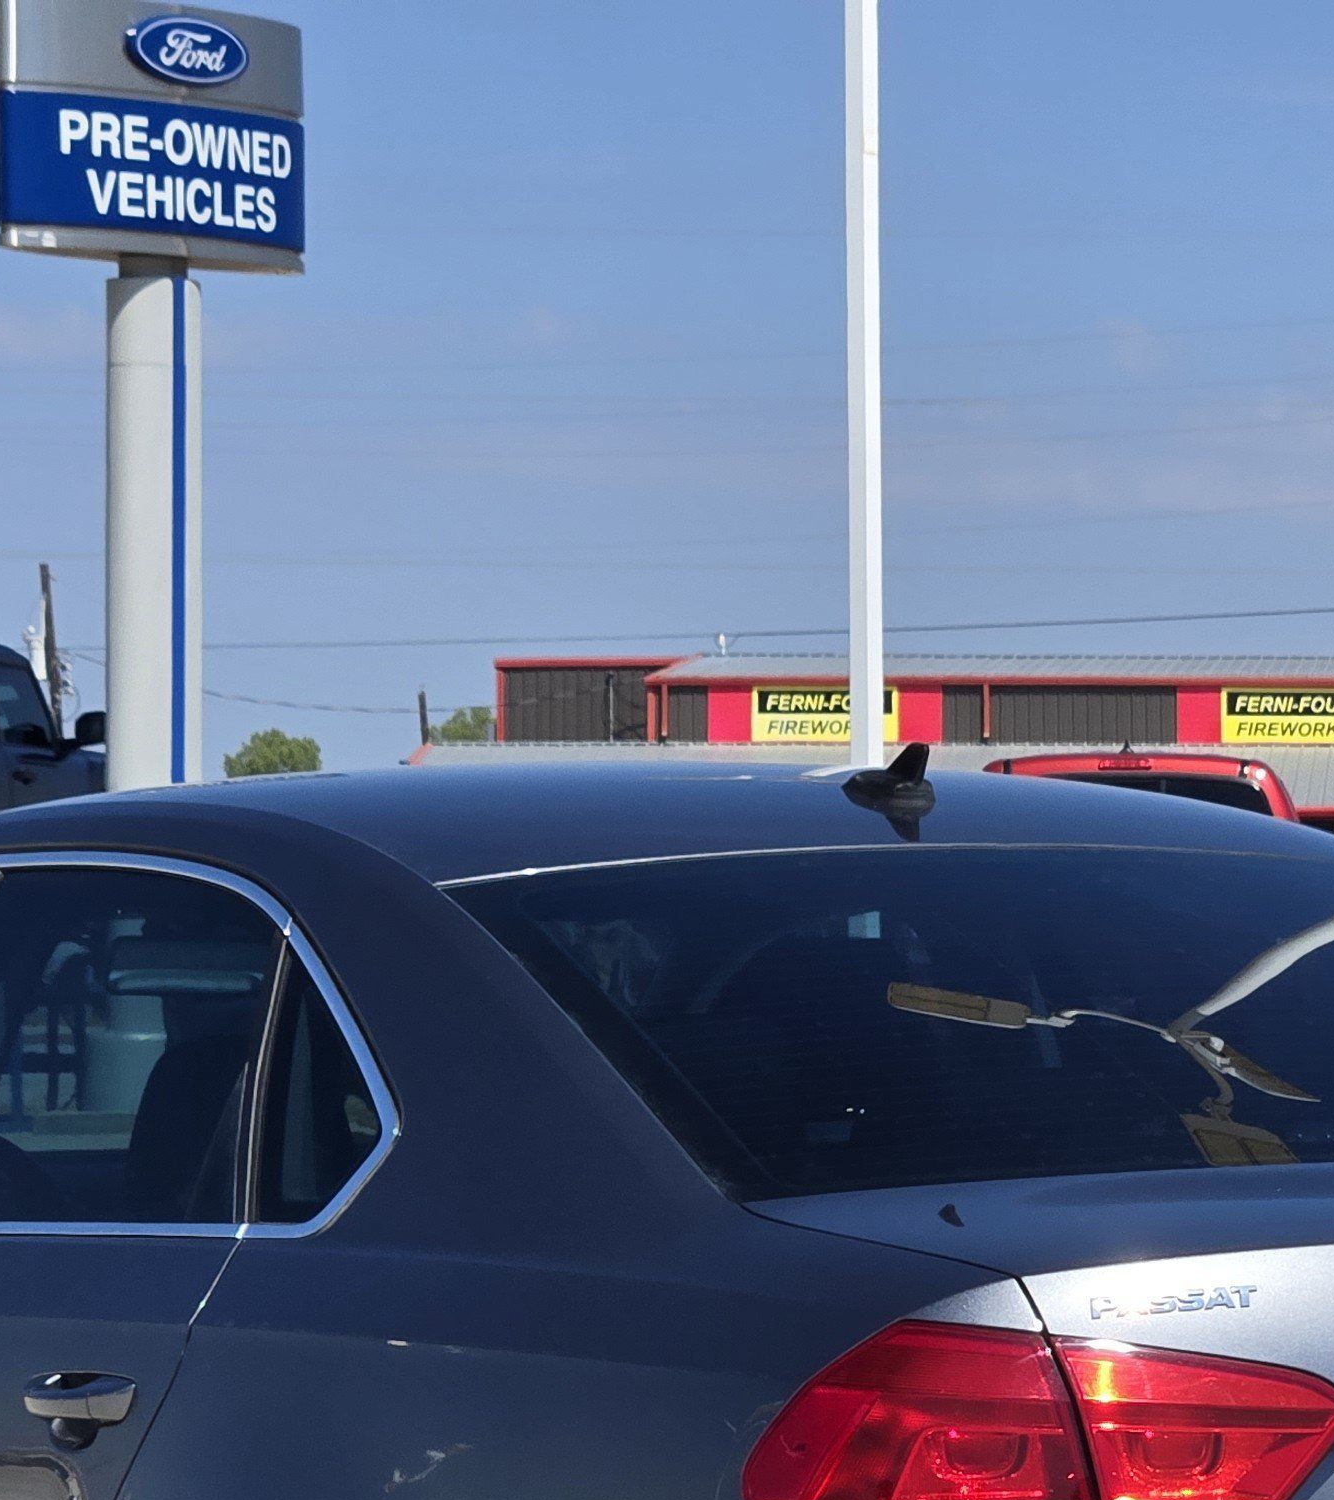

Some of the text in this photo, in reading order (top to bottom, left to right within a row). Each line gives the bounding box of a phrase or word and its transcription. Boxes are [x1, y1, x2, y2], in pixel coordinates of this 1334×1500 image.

[159, 28, 227, 72] Ford
[58, 109, 292, 179] PRE-OWNED
[86, 168, 277, 233] VEHICLES
[1089, 1284, 1258, 1320] PSSAT
